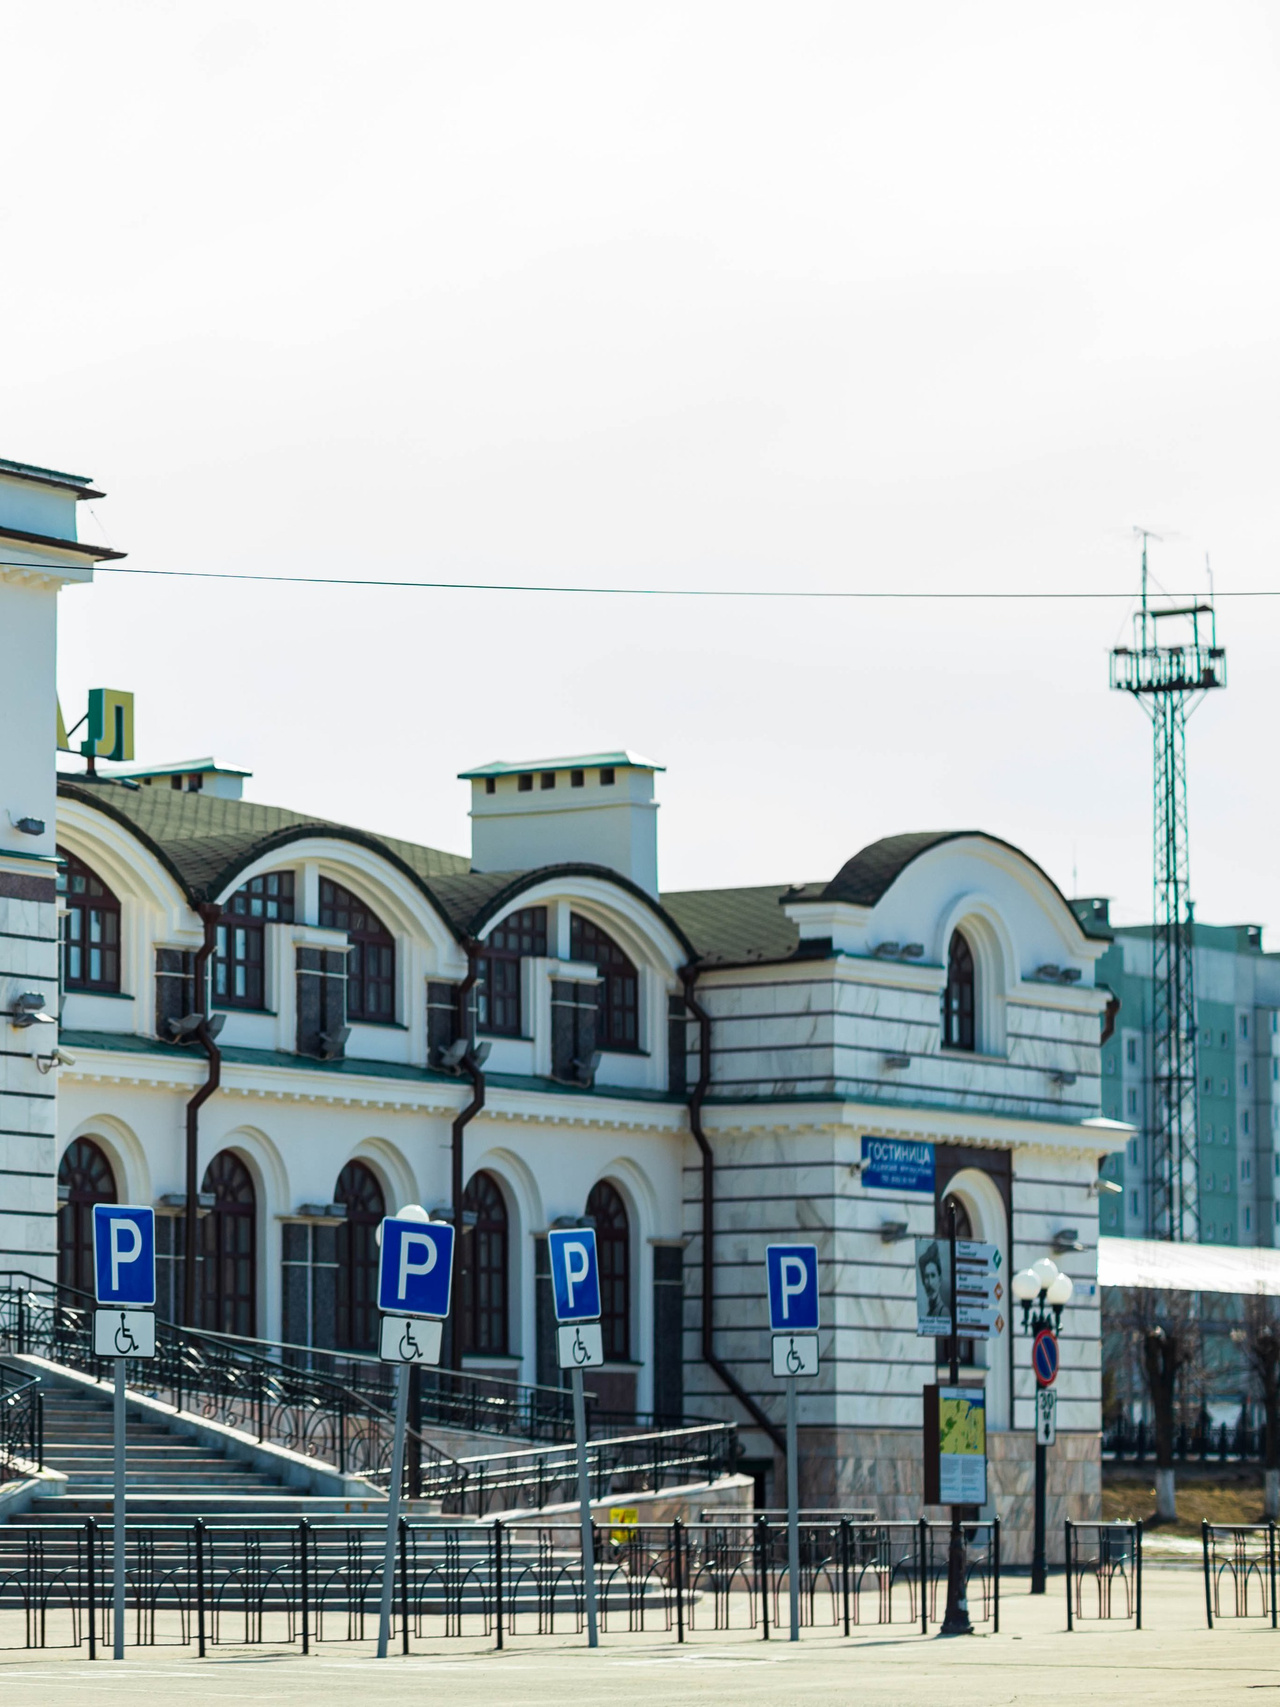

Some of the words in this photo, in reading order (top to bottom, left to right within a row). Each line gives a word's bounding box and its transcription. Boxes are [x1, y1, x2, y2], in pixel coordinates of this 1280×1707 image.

[57, 688, 134, 761] Л
[867, 1142, 931, 1165] ГОСТИНИЦА
[110, 1218, 143, 1291] P
[397, 1231, 438, 1300] P
[563, 1242, 590, 1309] P
[780, 1256, 808, 1320] P
[1040, 1392, 1054, 1410] 30
